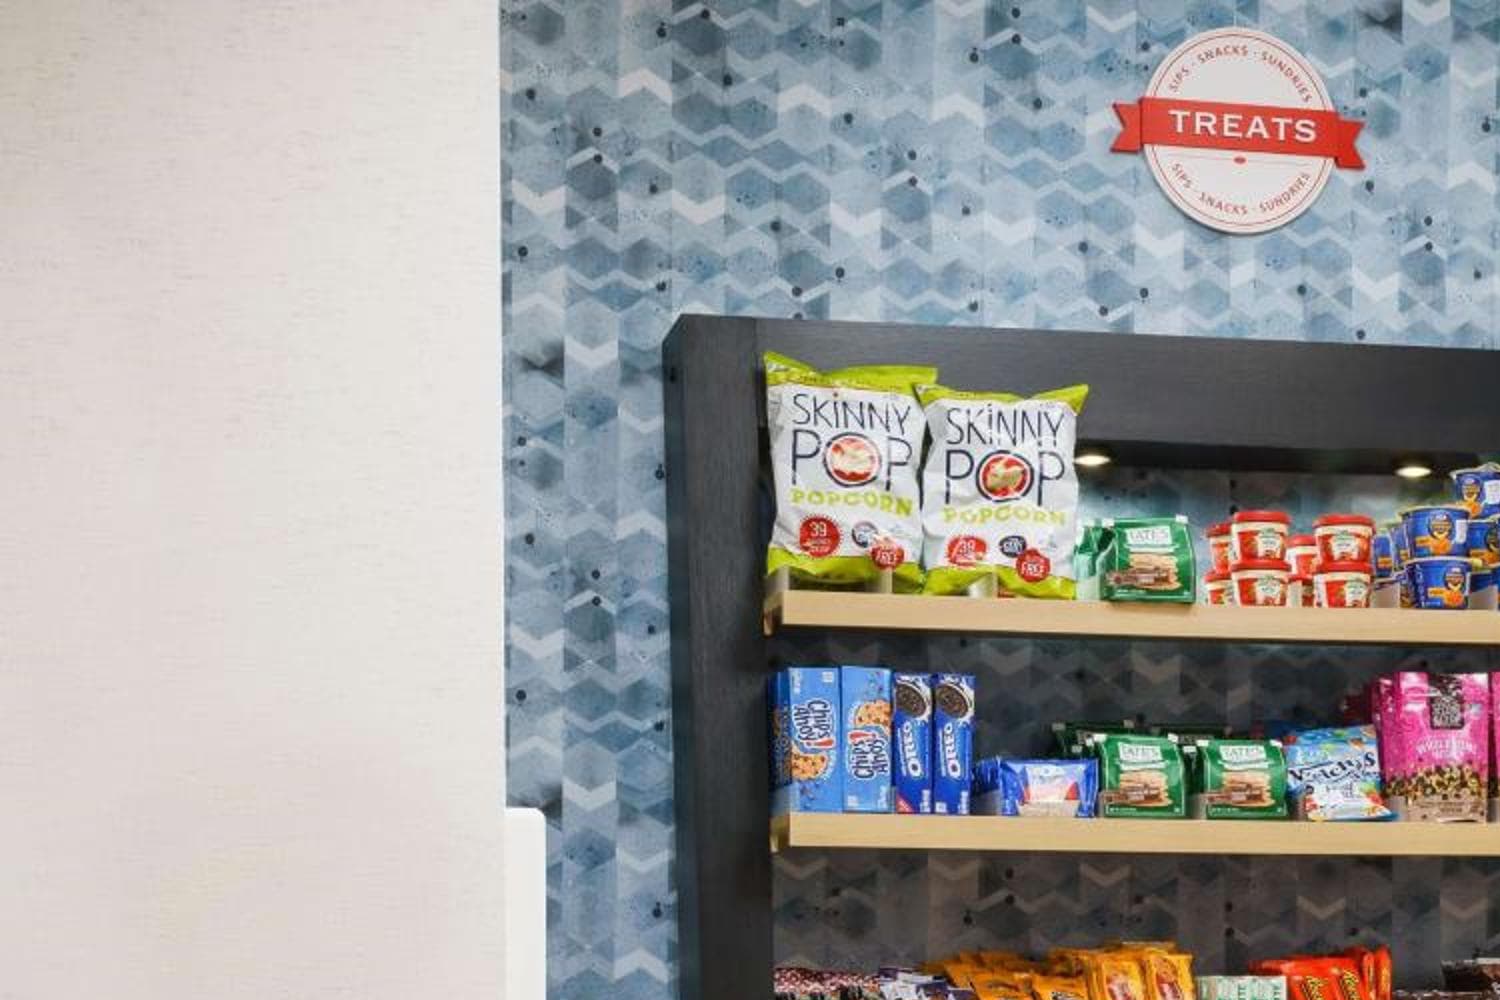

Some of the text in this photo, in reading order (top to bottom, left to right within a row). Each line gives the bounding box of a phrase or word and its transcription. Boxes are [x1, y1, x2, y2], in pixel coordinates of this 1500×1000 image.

[1168, 44, 1314, 104] SIPS SNACKS SUNDRIES
[1168, 109, 1318, 143] TREATS
[1171, 162, 1193, 189] SIPS
[1199, 190, 1249, 215] SNACKS
[791, 429, 914, 491] POP
[945, 449, 1066, 506] POP
[789, 488, 914, 517] POPCORN
[942, 506, 1067, 526] POPCORN
[809, 520, 828, 537] 39
[807, 699, 832, 739] Chips
[851, 739, 875, 779] Chips
[943, 721, 961, 778] OREO
